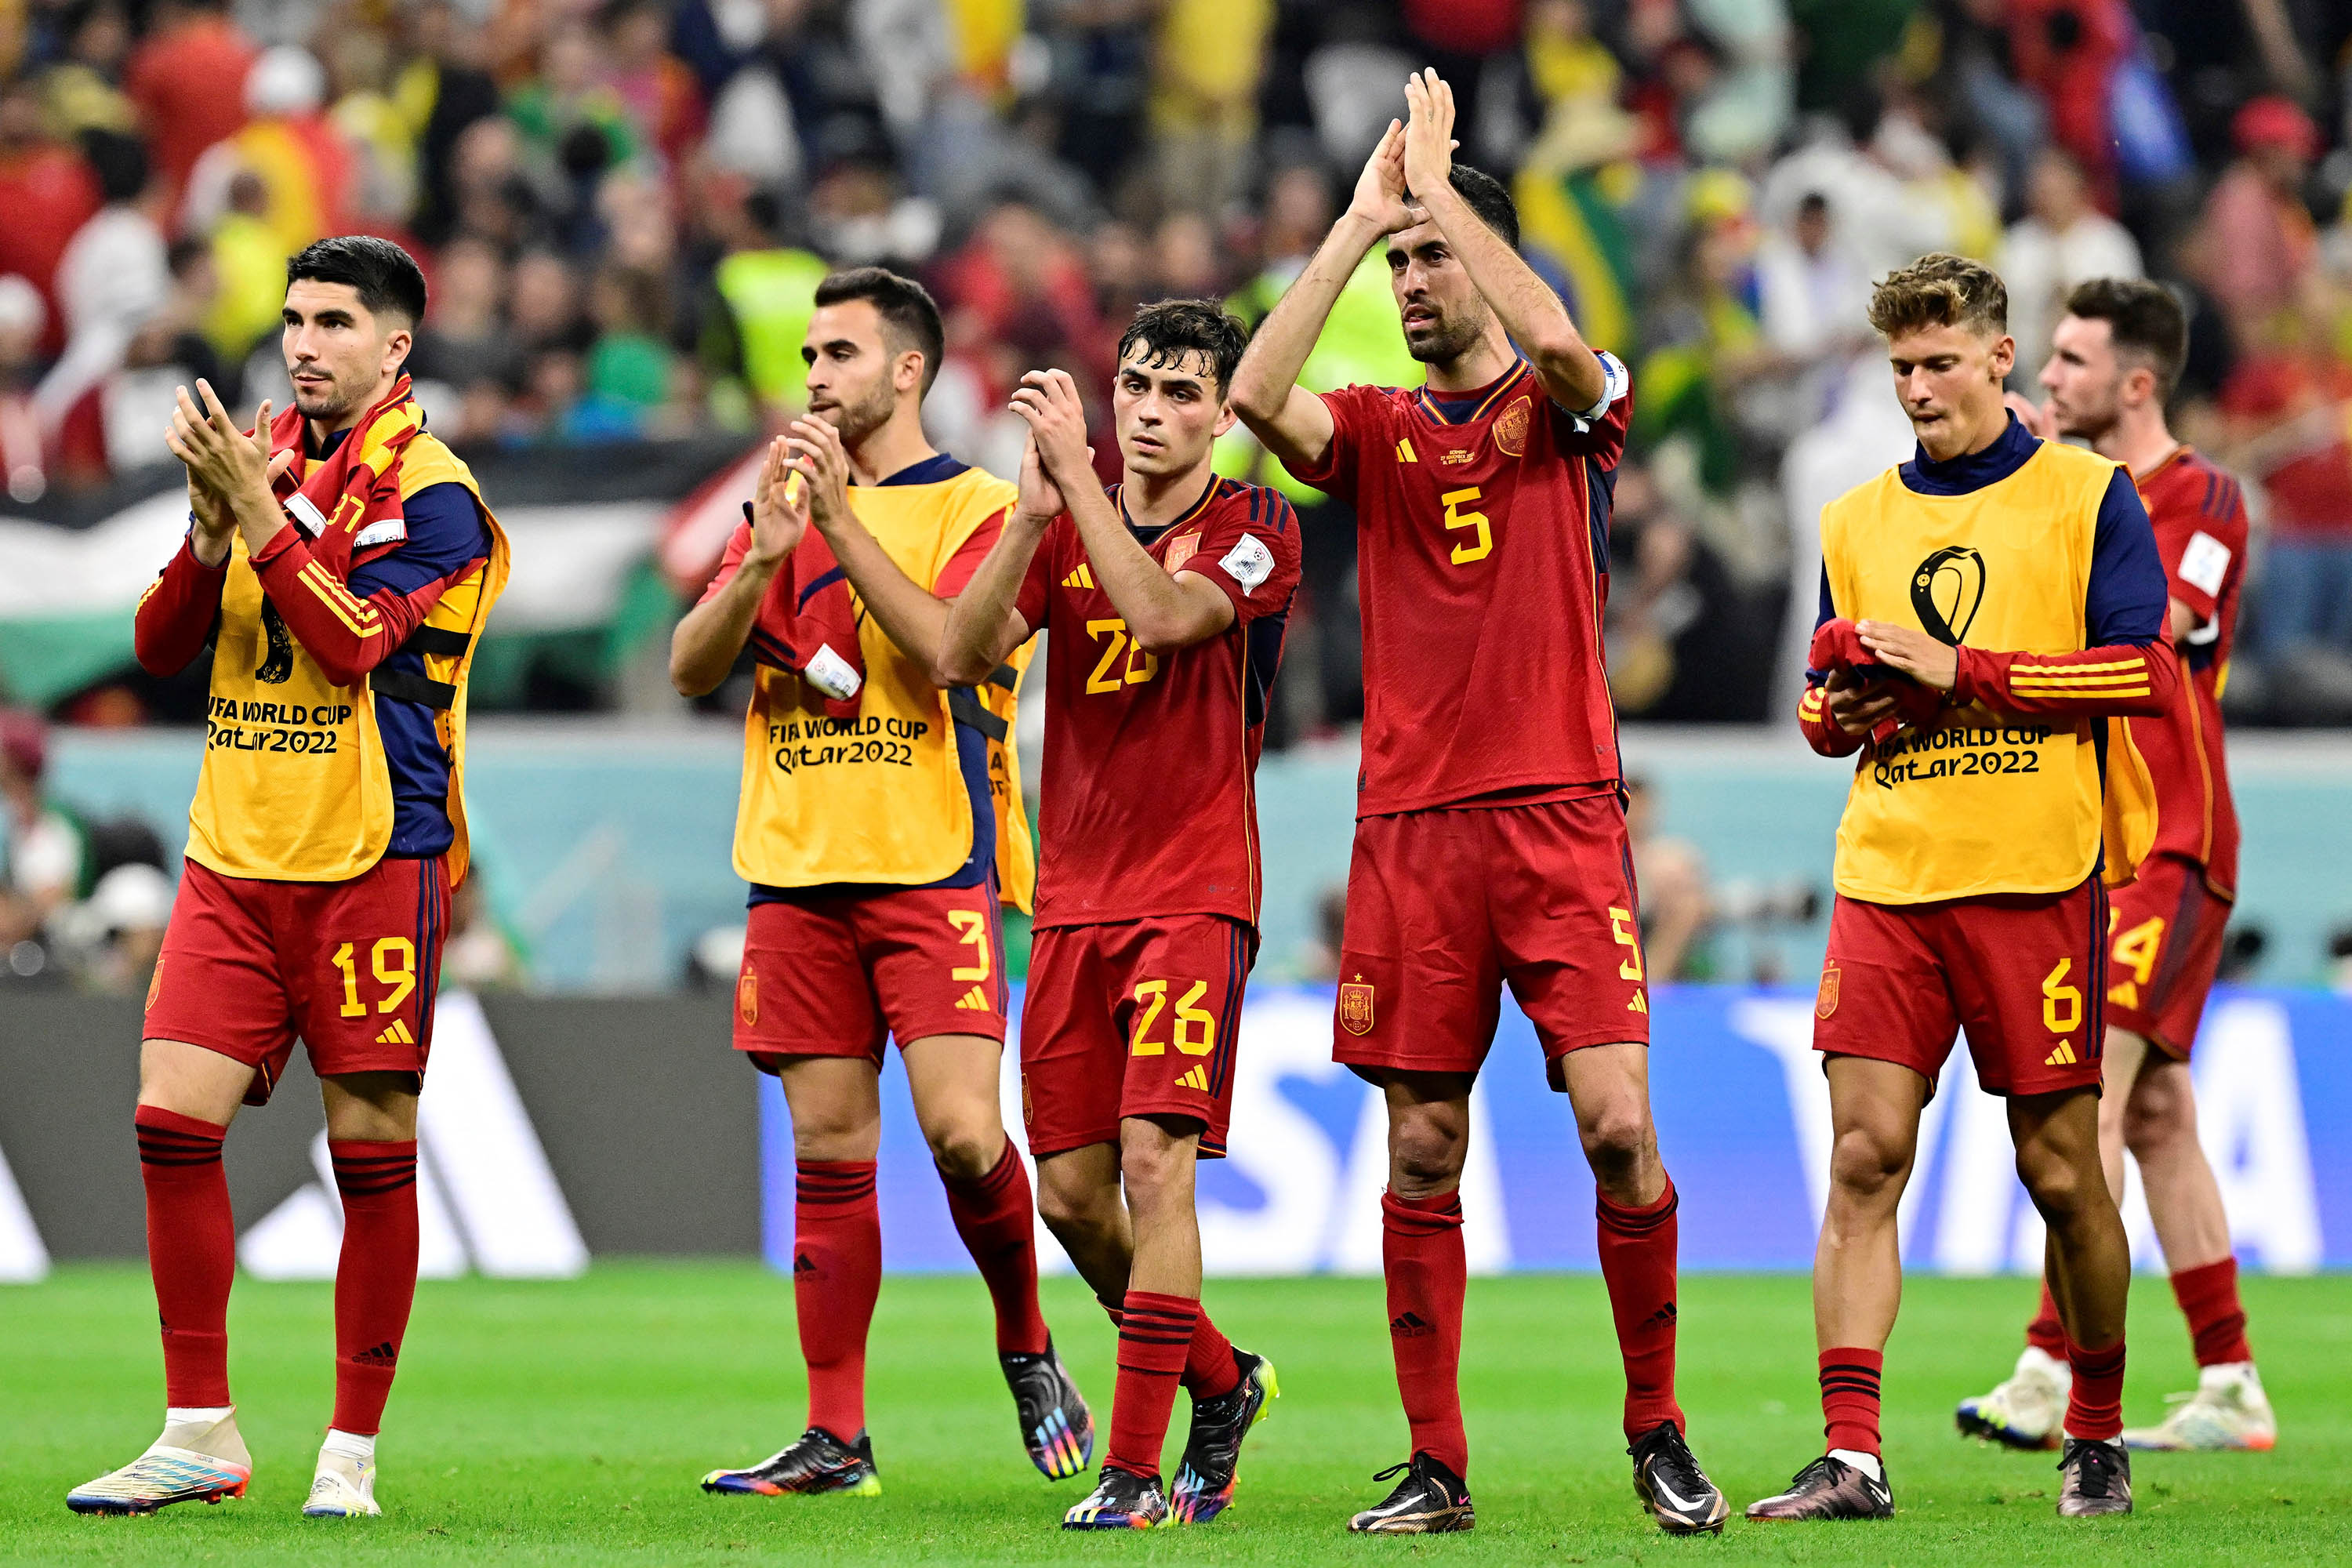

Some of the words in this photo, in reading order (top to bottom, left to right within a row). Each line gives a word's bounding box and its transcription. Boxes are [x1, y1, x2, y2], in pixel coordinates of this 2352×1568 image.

[1441, 485, 1494, 565] 5
[1086, 618, 1159, 695] 26
[242, 701, 308, 725] WORLD
[311, 705, 352, 726] CUP
[804, 716, 880, 739] WORLD
[886, 717, 928, 740] CUP
[1910, 726, 1998, 753] WORLD
[2002, 724, 2052, 745] CUP
[1873, 750, 2040, 791] Qatar2022
[332, 936, 416, 1018] 19
[948, 909, 990, 982] 3
[1608, 906, 1643, 982] 5
[2107, 906, 2165, 985] 4
[1131, 979, 1216, 1057] 26
[2042, 957, 2083, 1033] 6
[351, 1355, 396, 1367] adida
